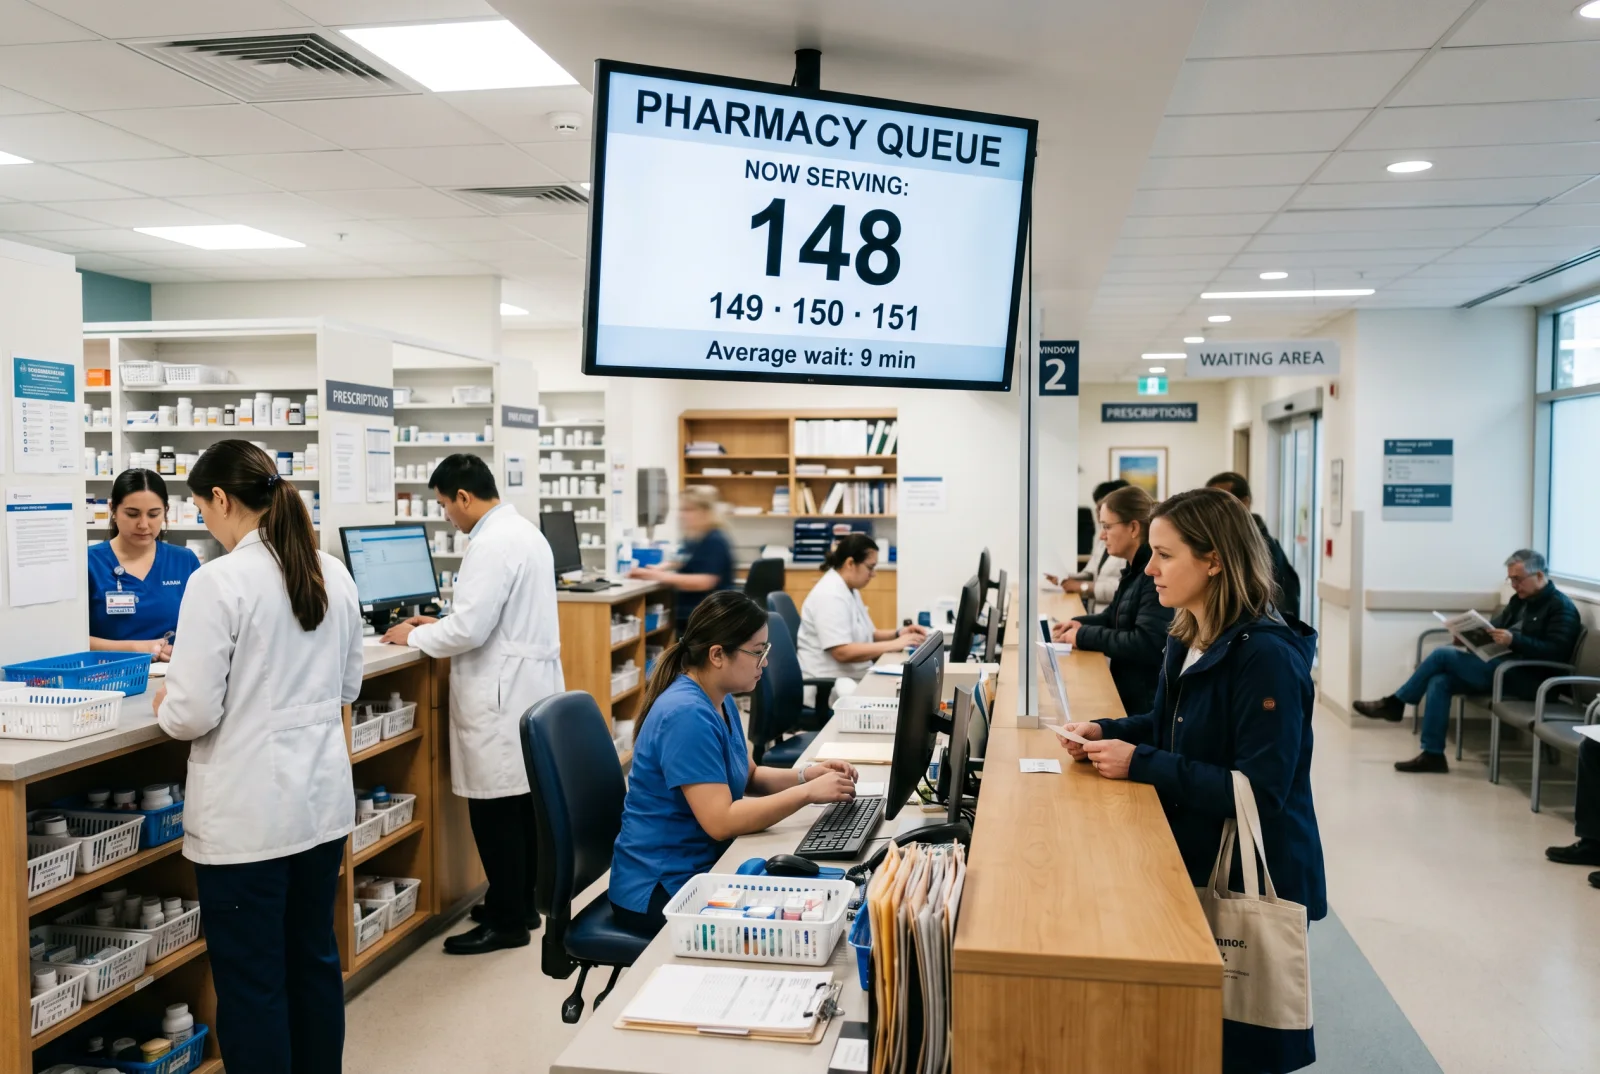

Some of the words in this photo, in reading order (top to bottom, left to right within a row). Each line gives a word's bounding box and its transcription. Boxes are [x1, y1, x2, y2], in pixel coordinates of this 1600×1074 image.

[636, 89, 868, 150] PHARMACY
[876, 122, 1002, 168] QUEUE
[745, 159, 801, 184] NOW
[806, 166, 909, 197] SERVING:
[751, 197, 902, 286] 148
[710, 291, 763, 322] 149
[793, 297, 844, 327] 150
[872, 303, 918, 331] 151
[705, 340, 797, 368] Average
[804, 346, 853, 369] wait:
[860, 348, 872, 367] 9
[878, 350, 916, 369] min
[1200, 352, 1273, 366] WAITING
[1279, 350, 1325, 365] AREA
[1045, 358, 1067, 390] 2
[332, 389, 389, 408] PRESCRIPTIONS
[1106, 407, 1193, 419] PRESCRIPTIONS
